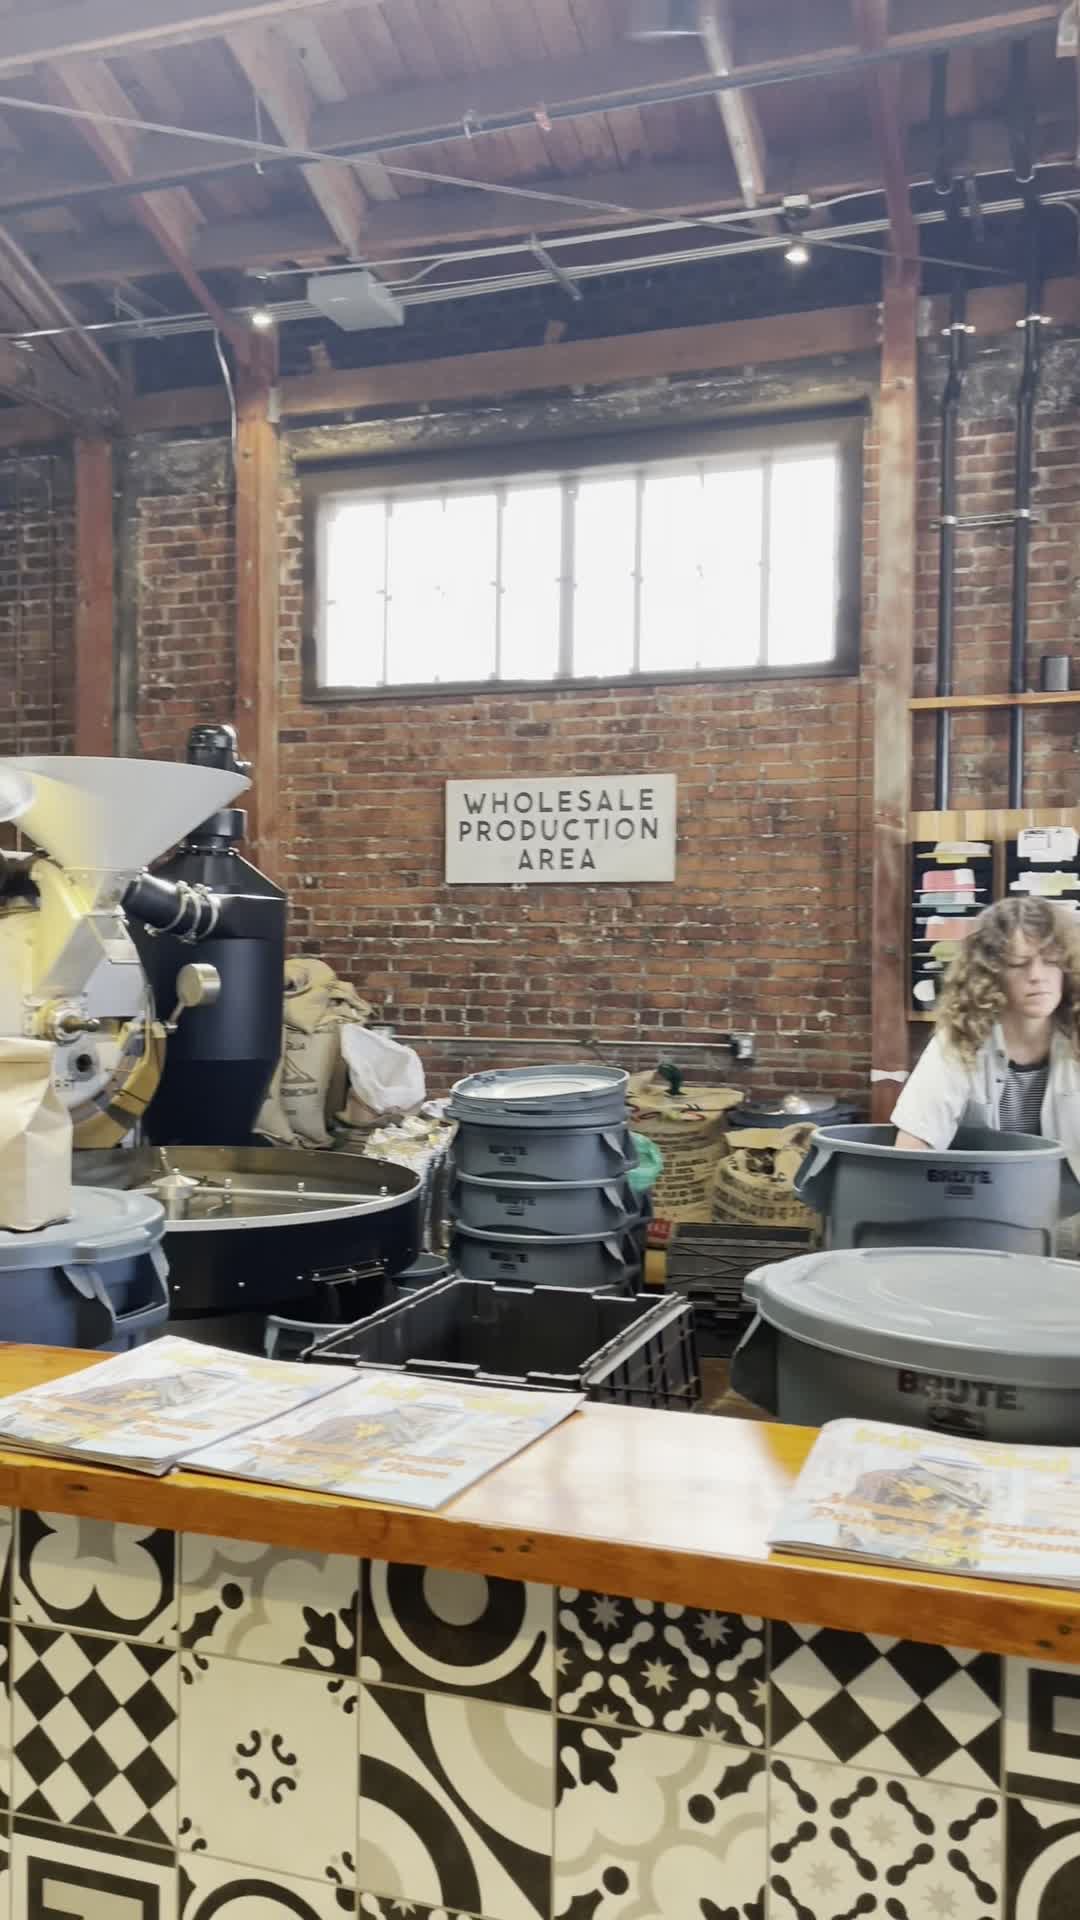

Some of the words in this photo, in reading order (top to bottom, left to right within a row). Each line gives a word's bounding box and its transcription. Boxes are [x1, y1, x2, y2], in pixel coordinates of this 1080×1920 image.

[463, 788, 654, 814] WHOLESALE
[458, 817, 659, 842] PRODUCTION
[518, 848, 597, 870] AREA
[897, 1369, 1019, 1411] BRUTE
